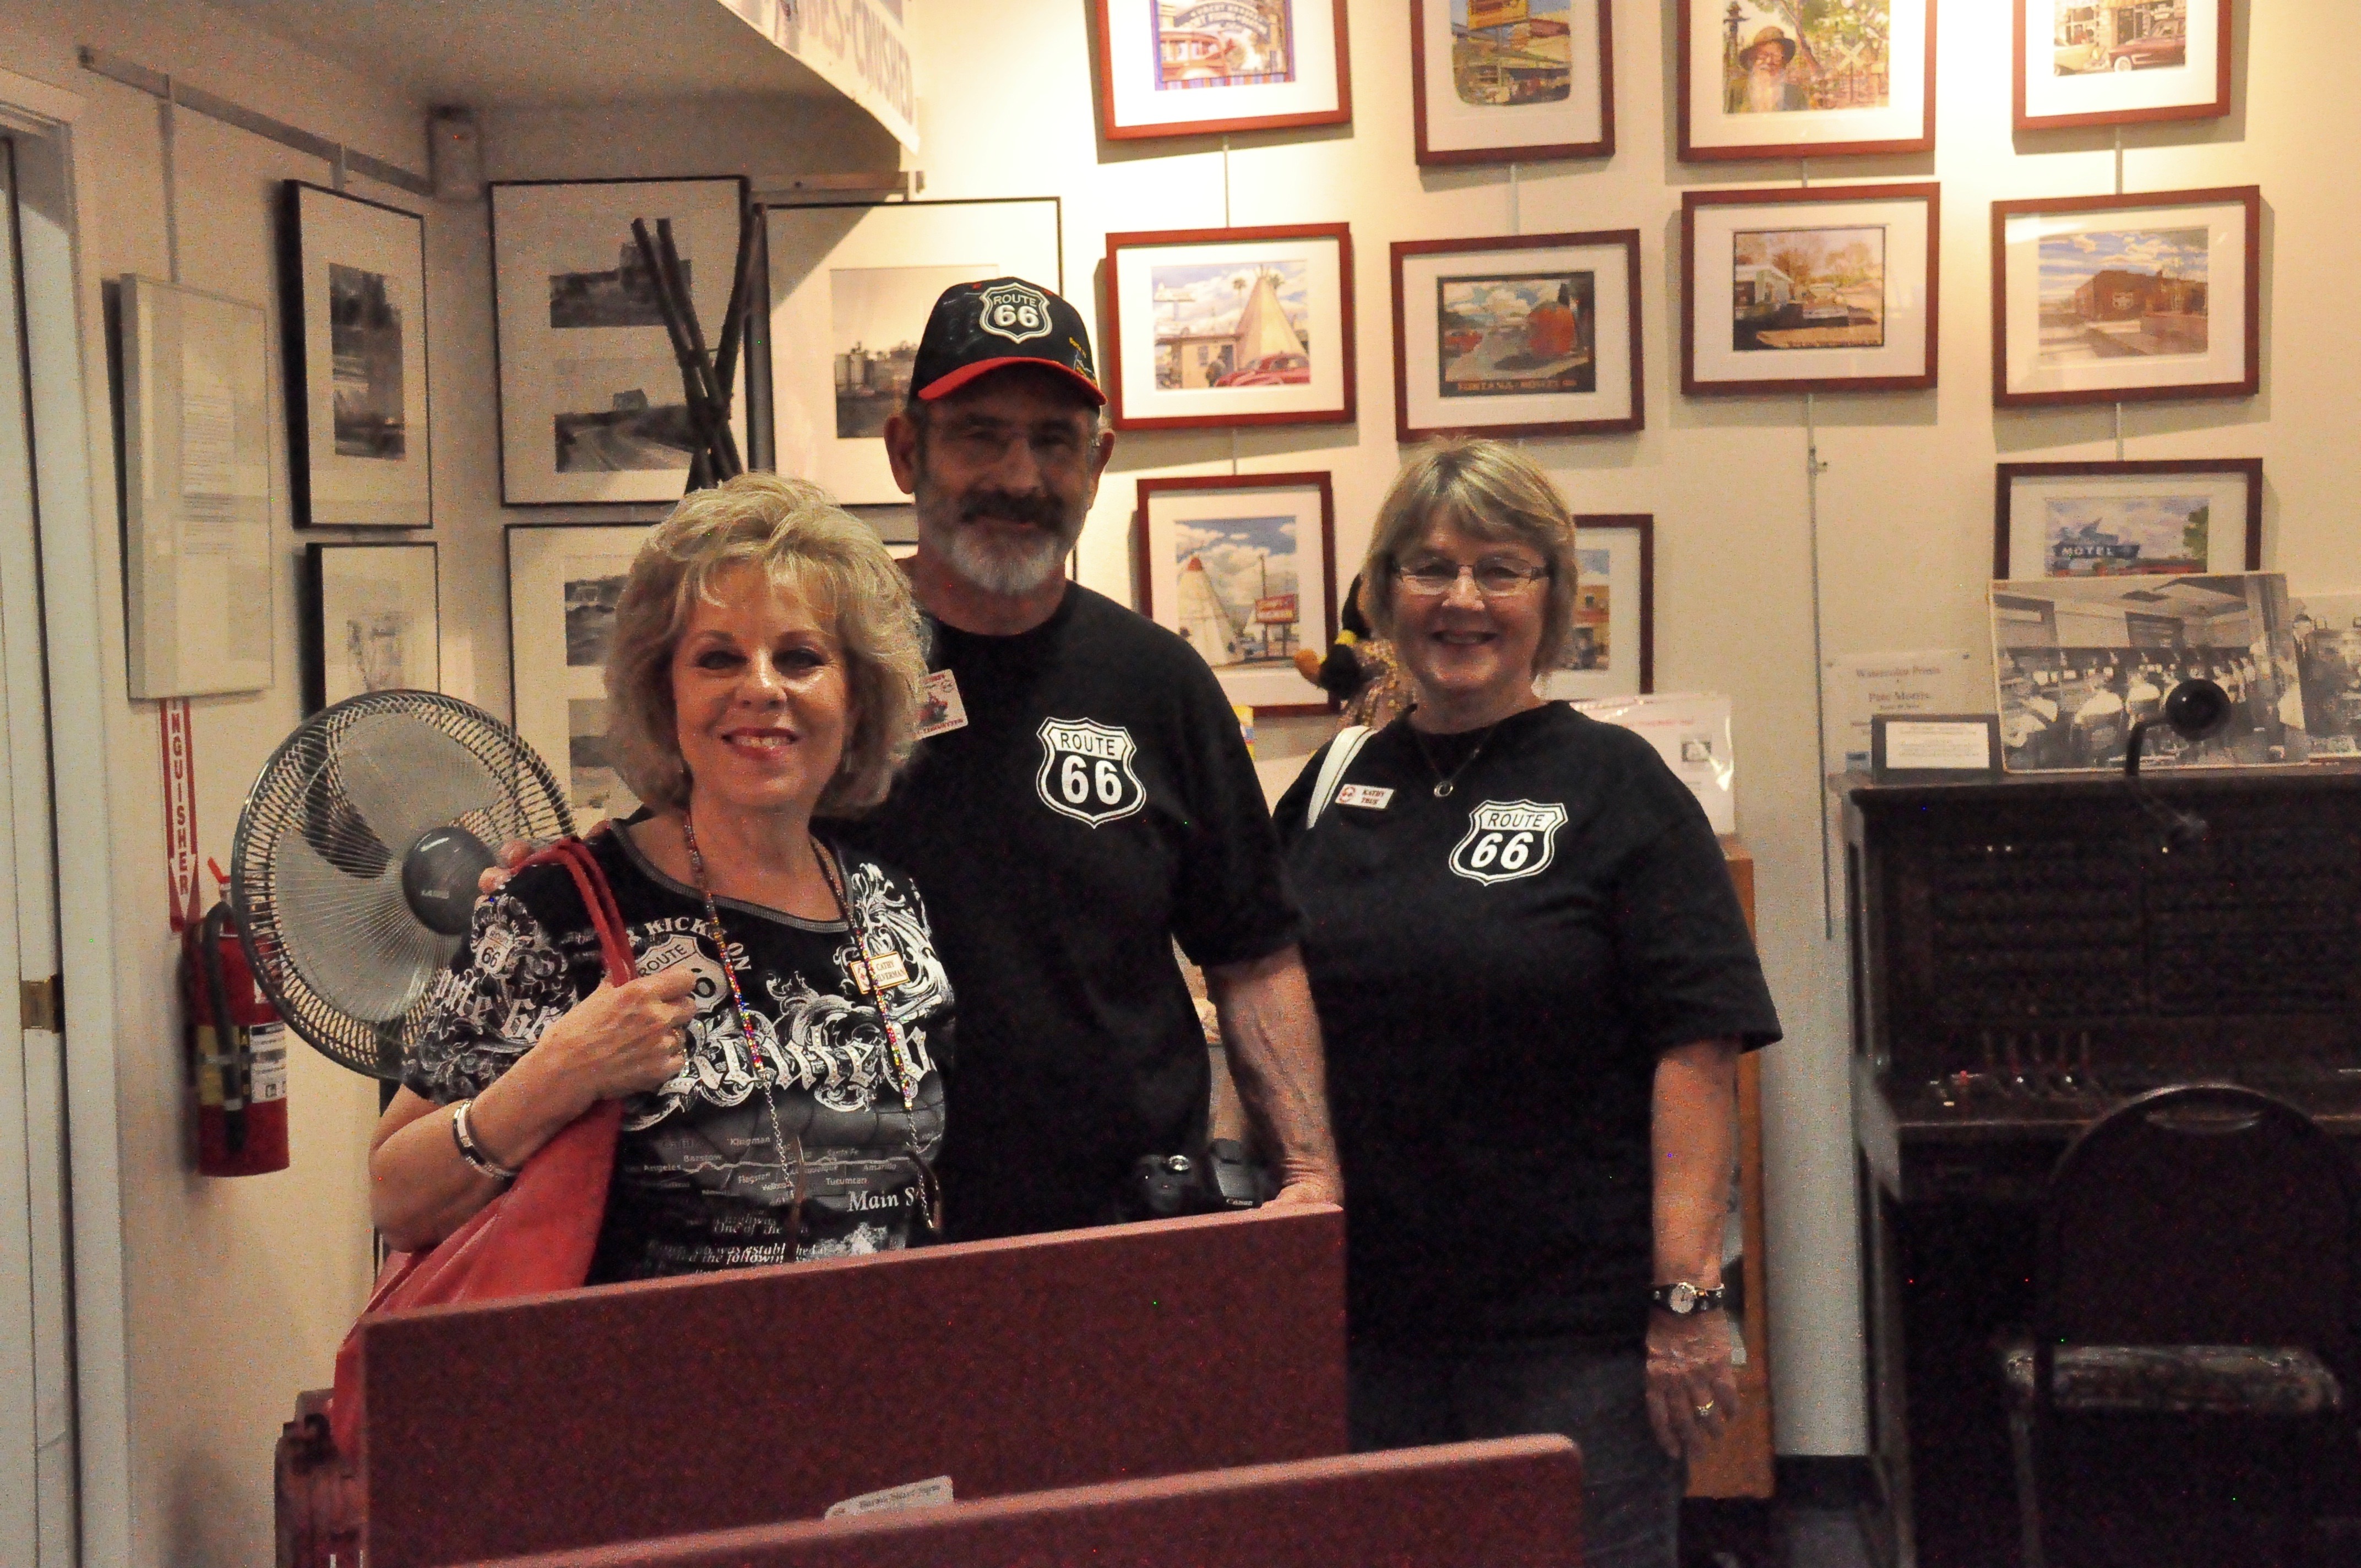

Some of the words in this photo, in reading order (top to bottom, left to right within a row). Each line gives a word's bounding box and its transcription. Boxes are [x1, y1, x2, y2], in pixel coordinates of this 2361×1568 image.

[993, 294, 1037, 308] ROUTE
[994, 304, 1040, 328] 66
[1060, 732, 1116, 756] ROUTE
[1062, 755, 1122, 805] 66
[1488, 813, 1545, 827] ROUTE
[1471, 831, 1534, 870] 66
[644, 917, 727, 941] KICK
[727, 942, 752, 971] ON
[481, 946, 501, 968] 66
[638, 944, 688, 977] ROUTE
[876, 969, 904, 982] ILVERMAN
[730, 1136, 770, 1146] Kingman
[644, 1164, 681, 1173] Angeles
[863, 1163, 896, 1172] Amarillo
[848, 1188, 899, 1211] Main
